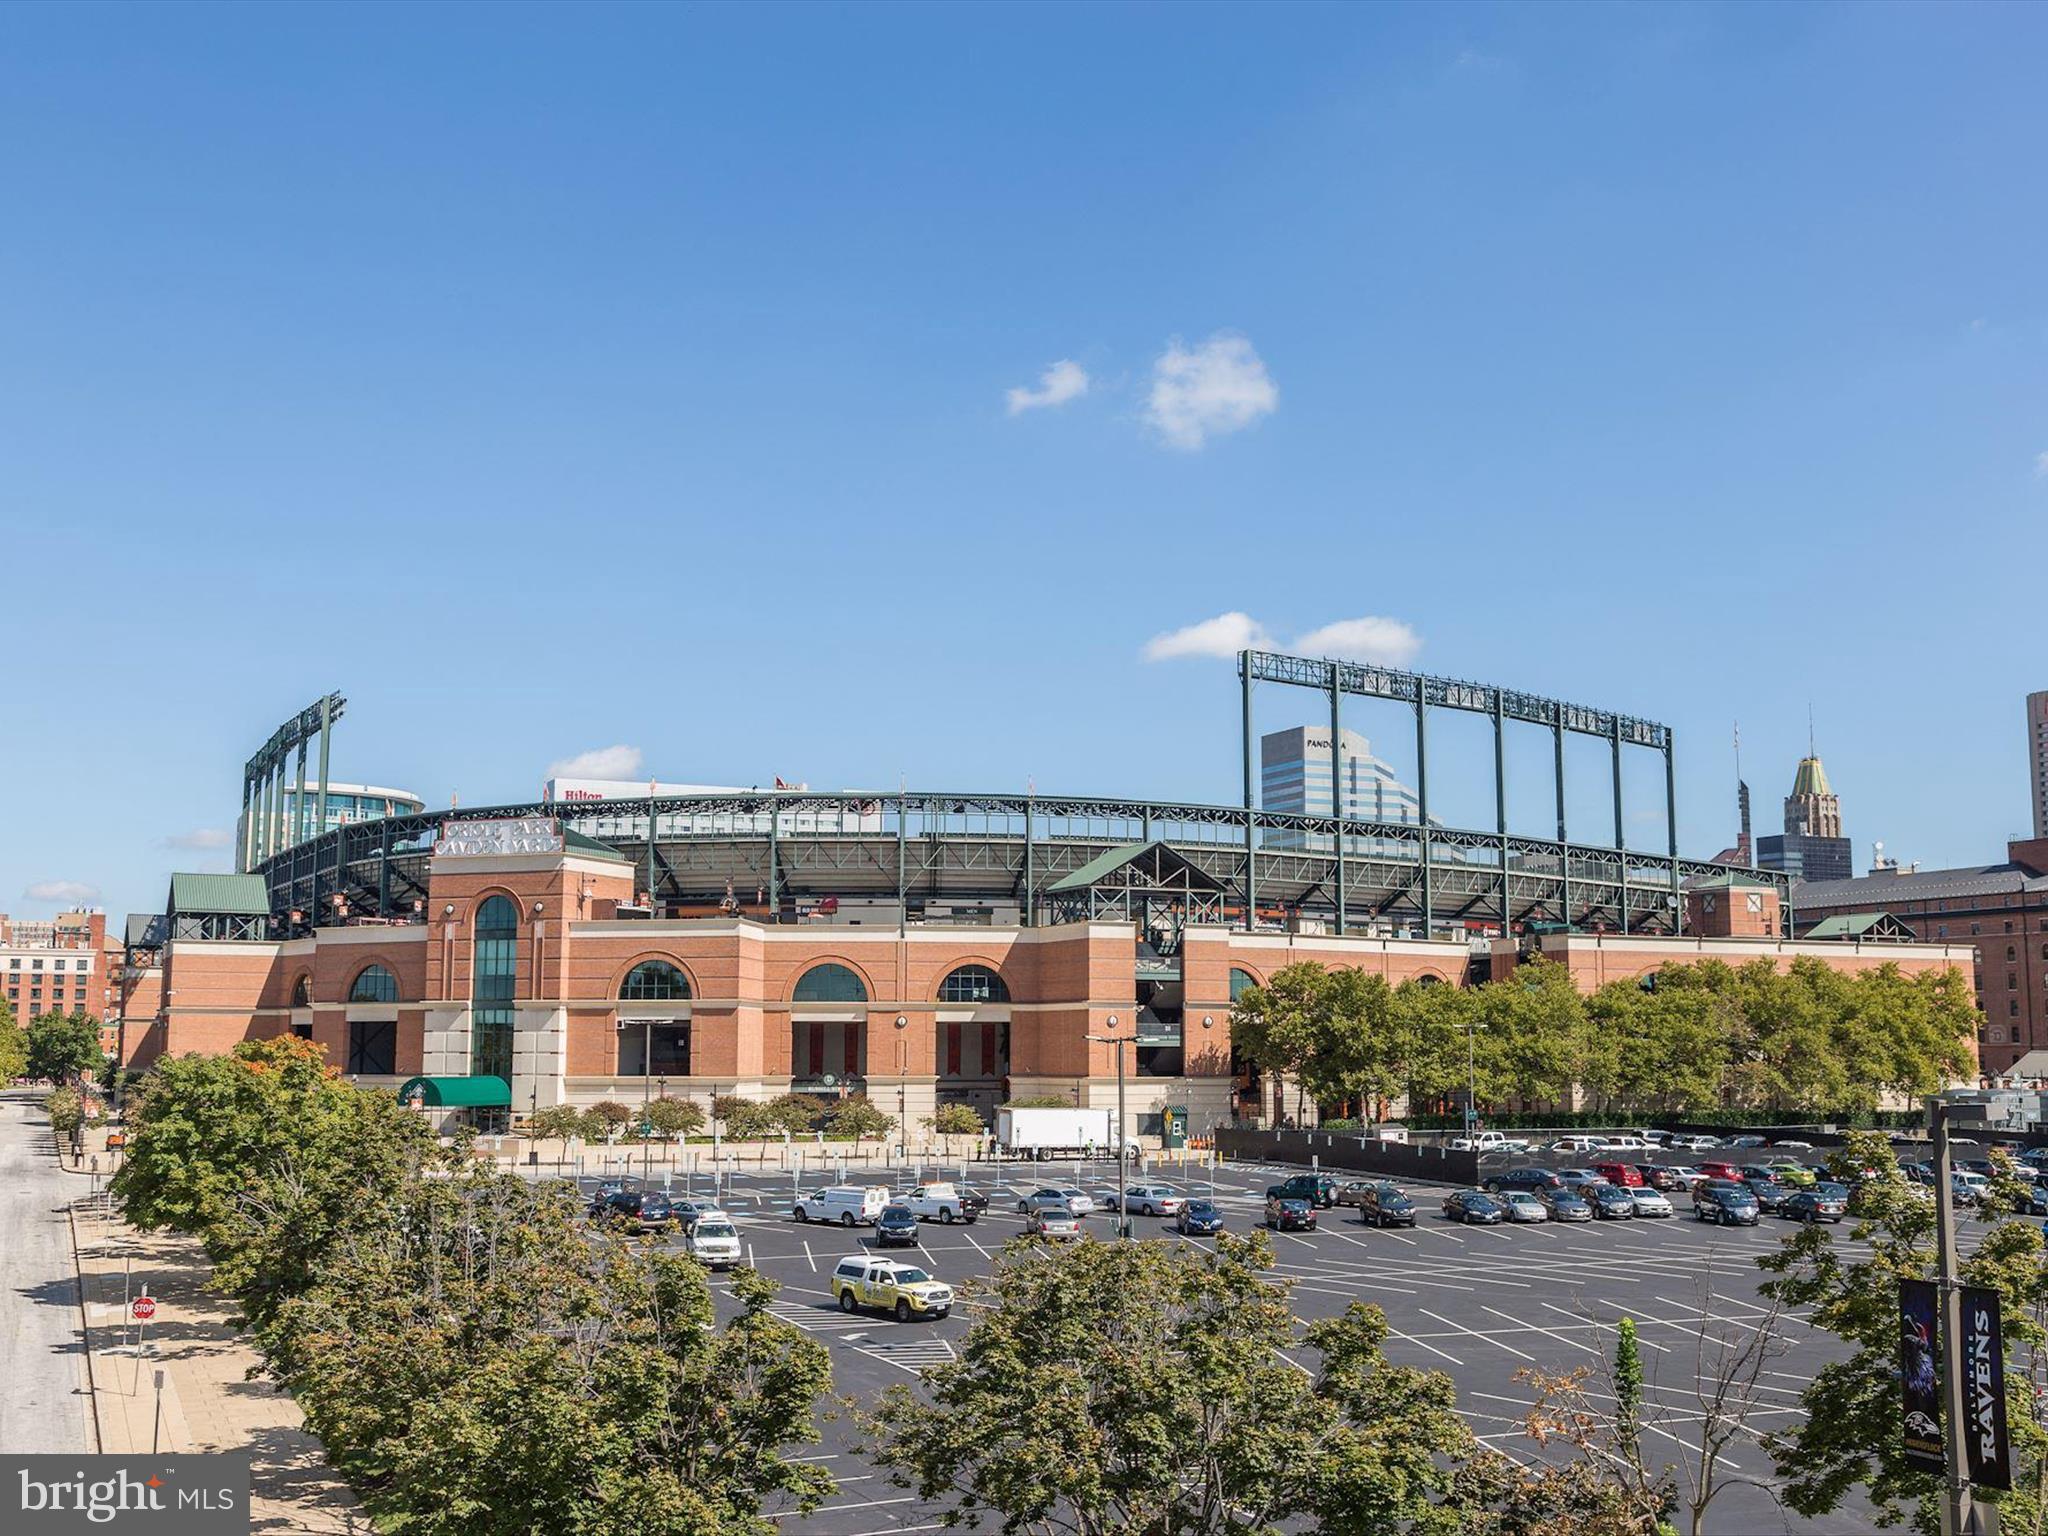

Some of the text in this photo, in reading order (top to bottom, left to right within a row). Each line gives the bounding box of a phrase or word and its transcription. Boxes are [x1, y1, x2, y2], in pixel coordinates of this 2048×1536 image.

[1307, 739, 1347, 750] PANDOA
[565, 789, 602, 801] Hilton
[447, 820, 551, 838] ORIOLE PARK
[435, 836, 562, 855] CAMDEN YARDS
[133, 1303, 155, 1313] STOP
[1968, 1335, 1978, 1432] BALTIMORE
[1974, 1310, 1997, 1464] RAVENS
